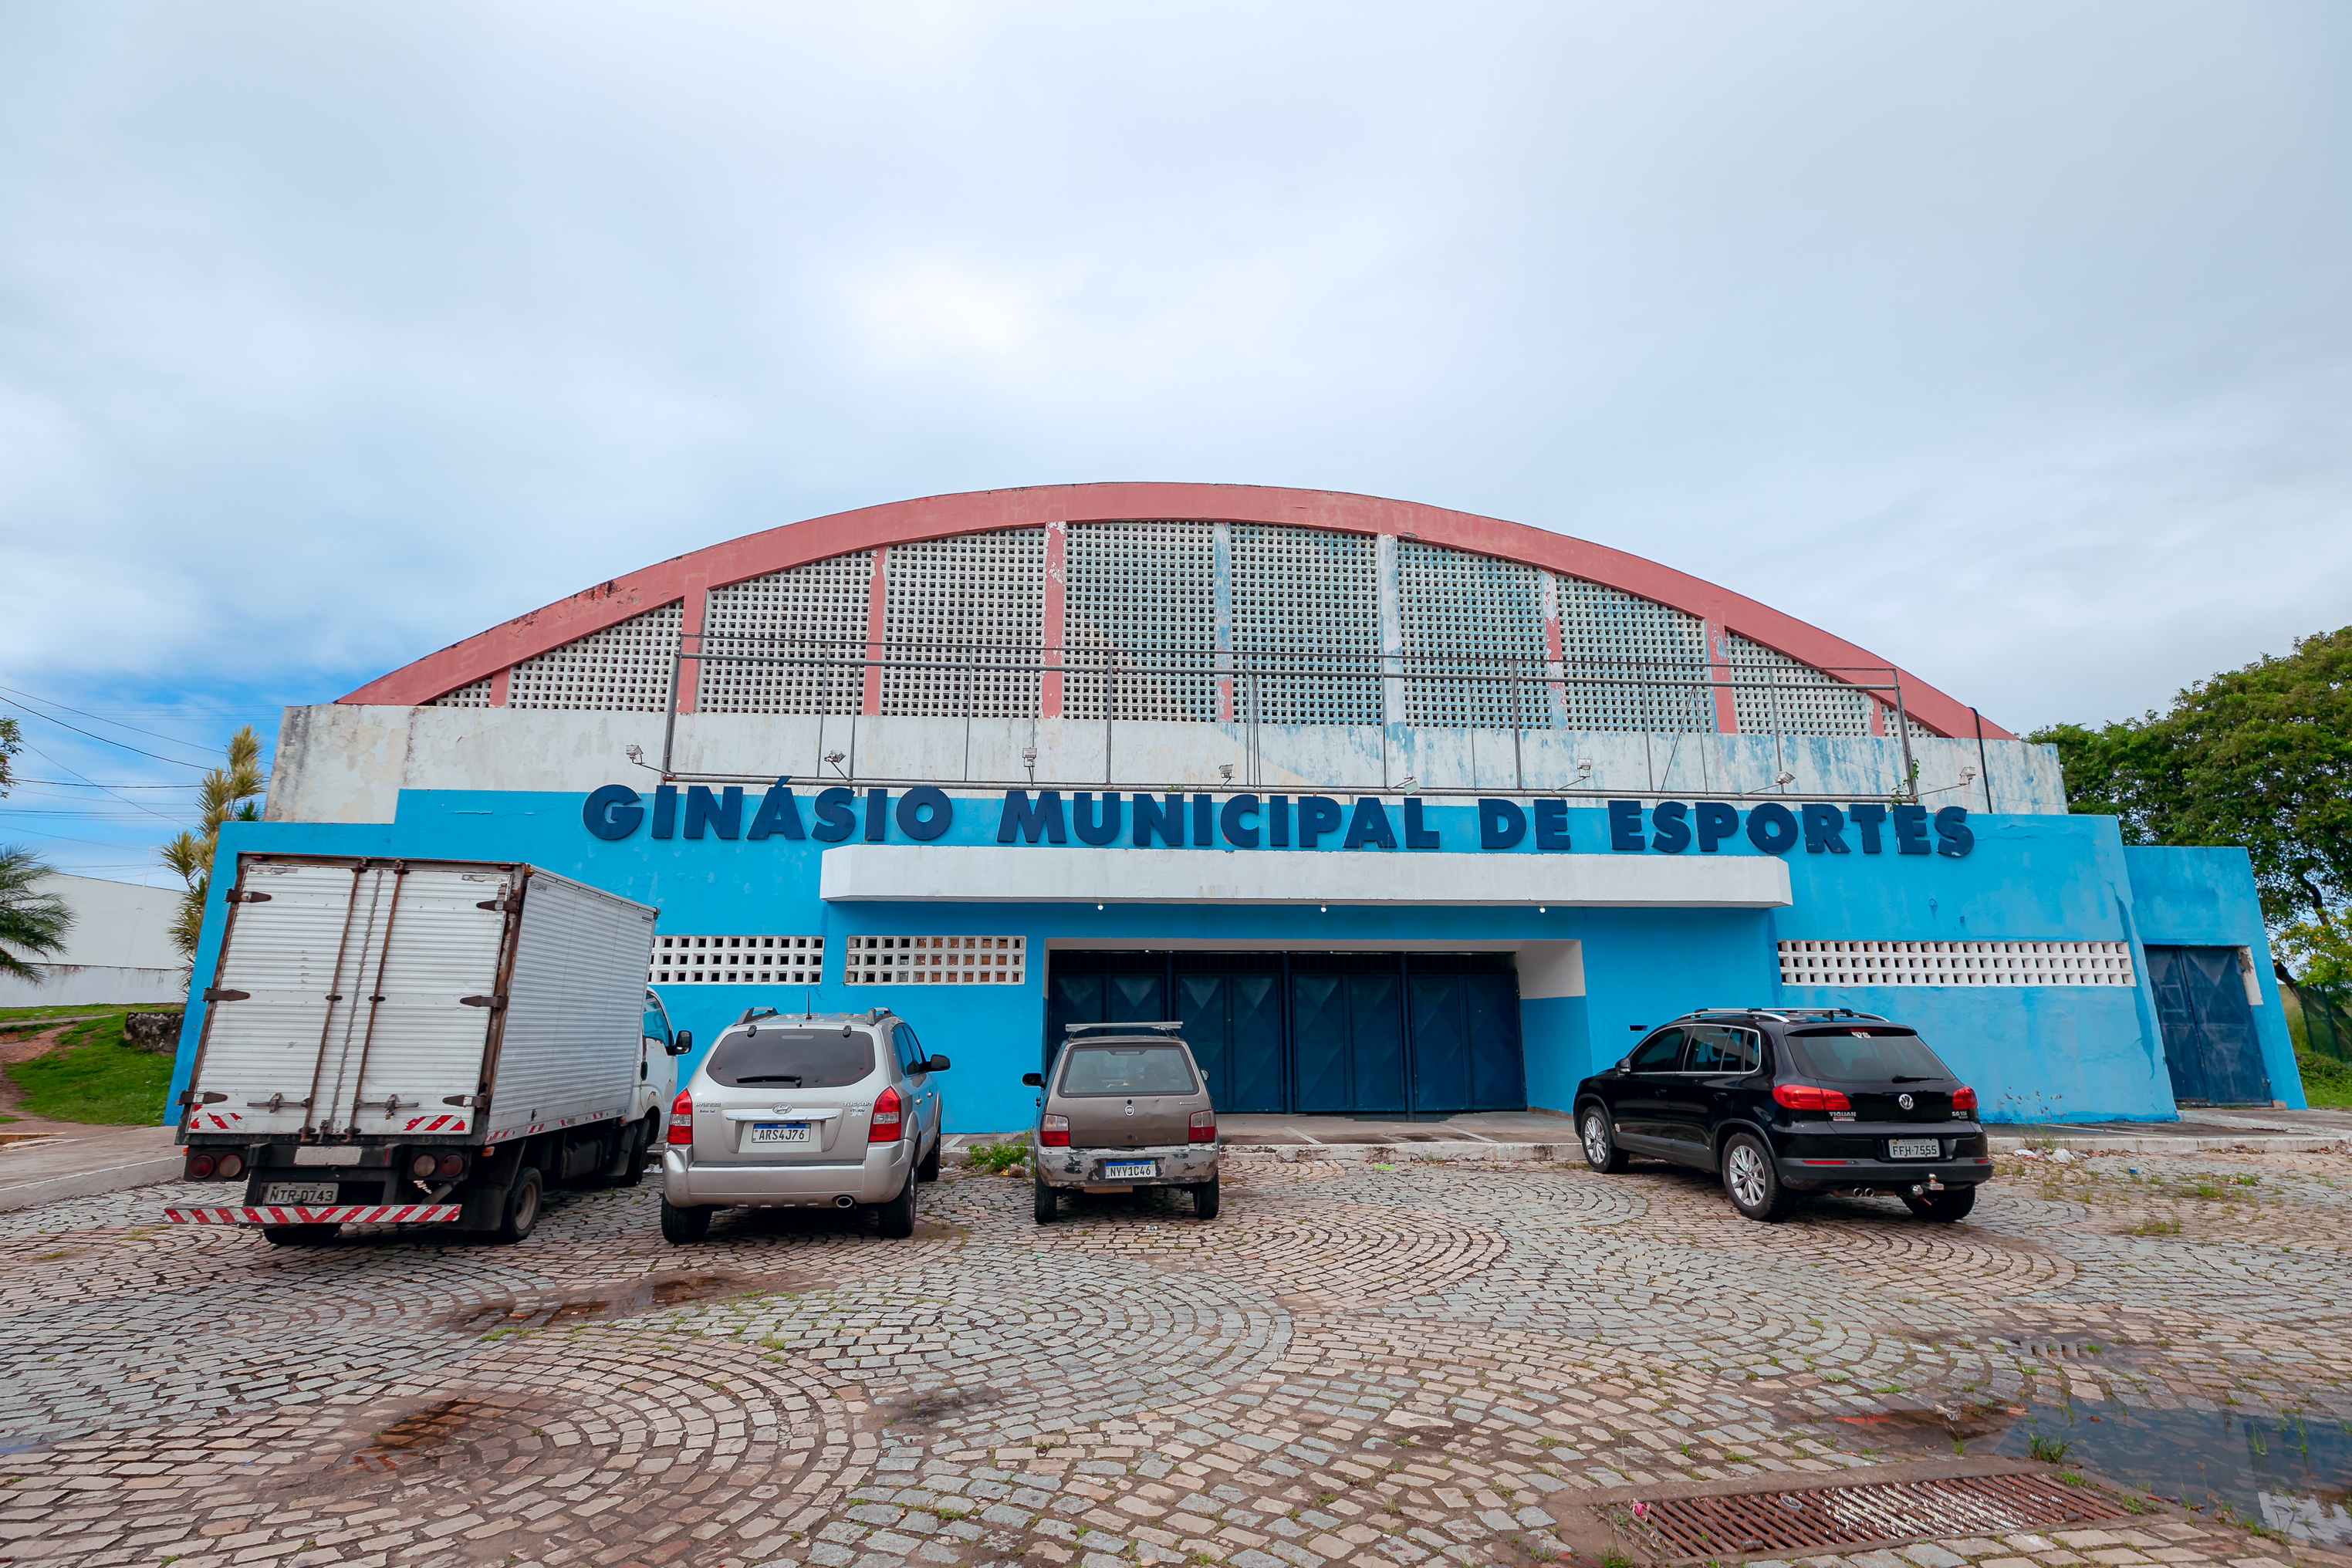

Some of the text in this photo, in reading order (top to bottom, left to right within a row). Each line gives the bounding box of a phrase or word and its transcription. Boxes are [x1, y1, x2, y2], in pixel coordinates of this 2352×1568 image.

[583, 776, 1975, 857] GINÁSIO MUNICIPAL DE ESPORTES
[759, 1129, 805, 1141] ARS4J76
[1110, 1165, 1151, 1177] NYY1C46
